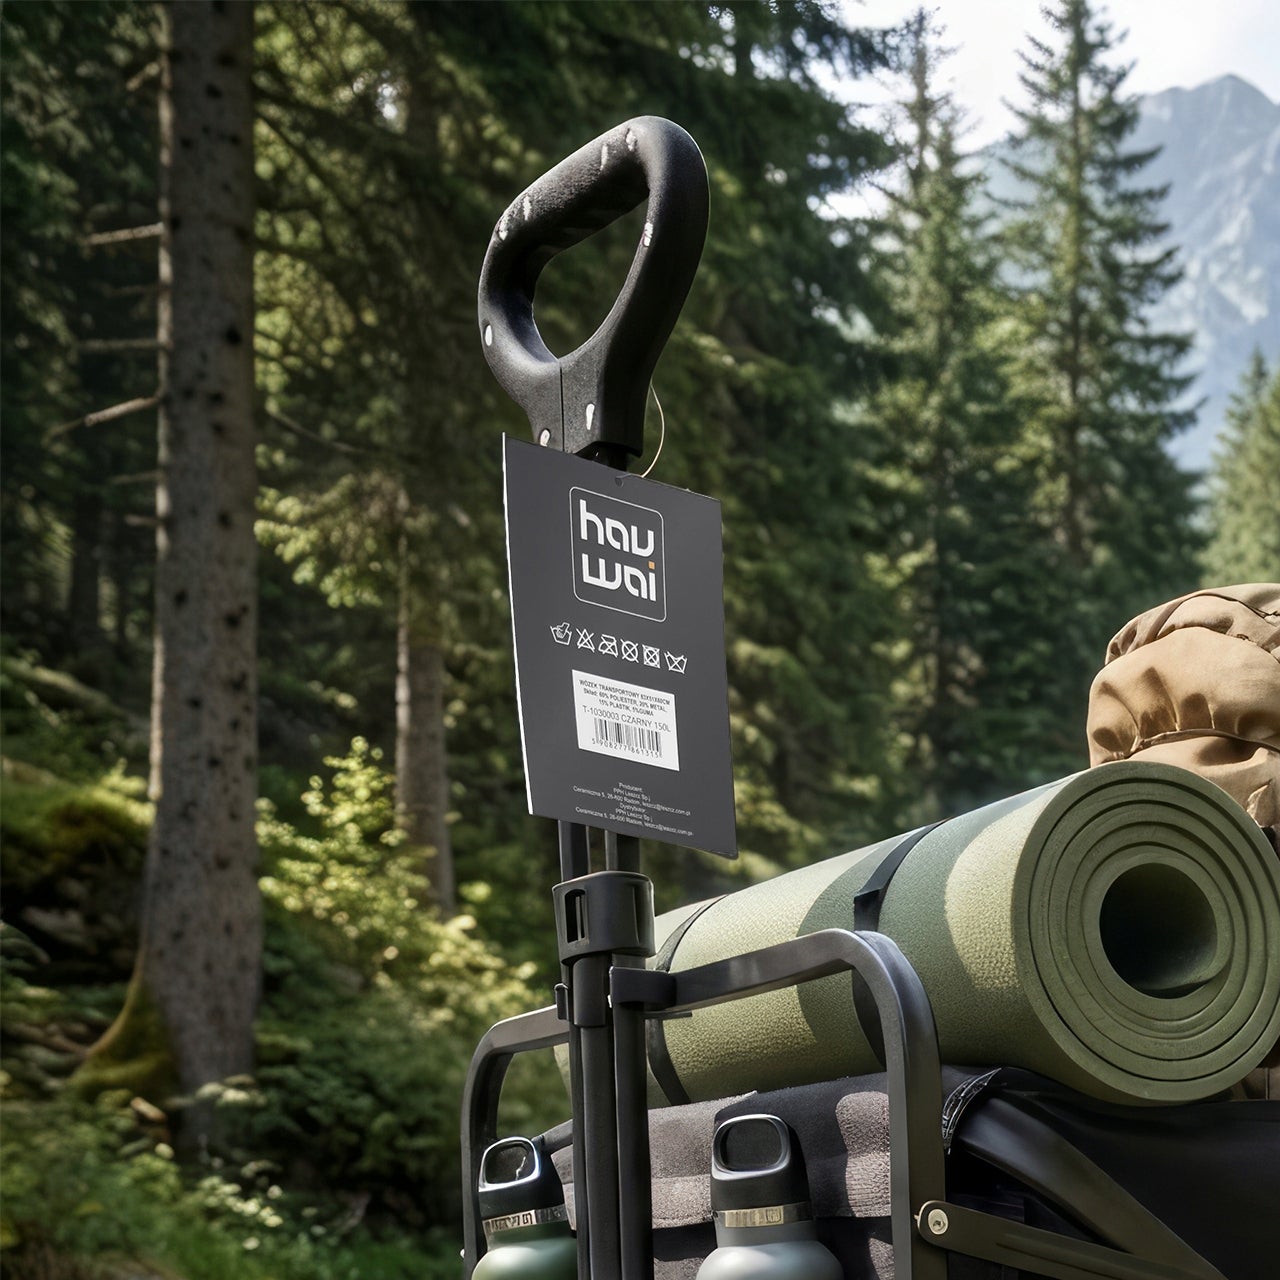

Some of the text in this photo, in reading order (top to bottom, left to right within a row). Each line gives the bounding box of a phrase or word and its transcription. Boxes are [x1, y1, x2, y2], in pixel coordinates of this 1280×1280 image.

[582, 553, 657, 602] wai
[599, 684, 639, 698] TRANSPORTOWY
[583, 705, 671, 733] T-1030003 CZARNY 150L
